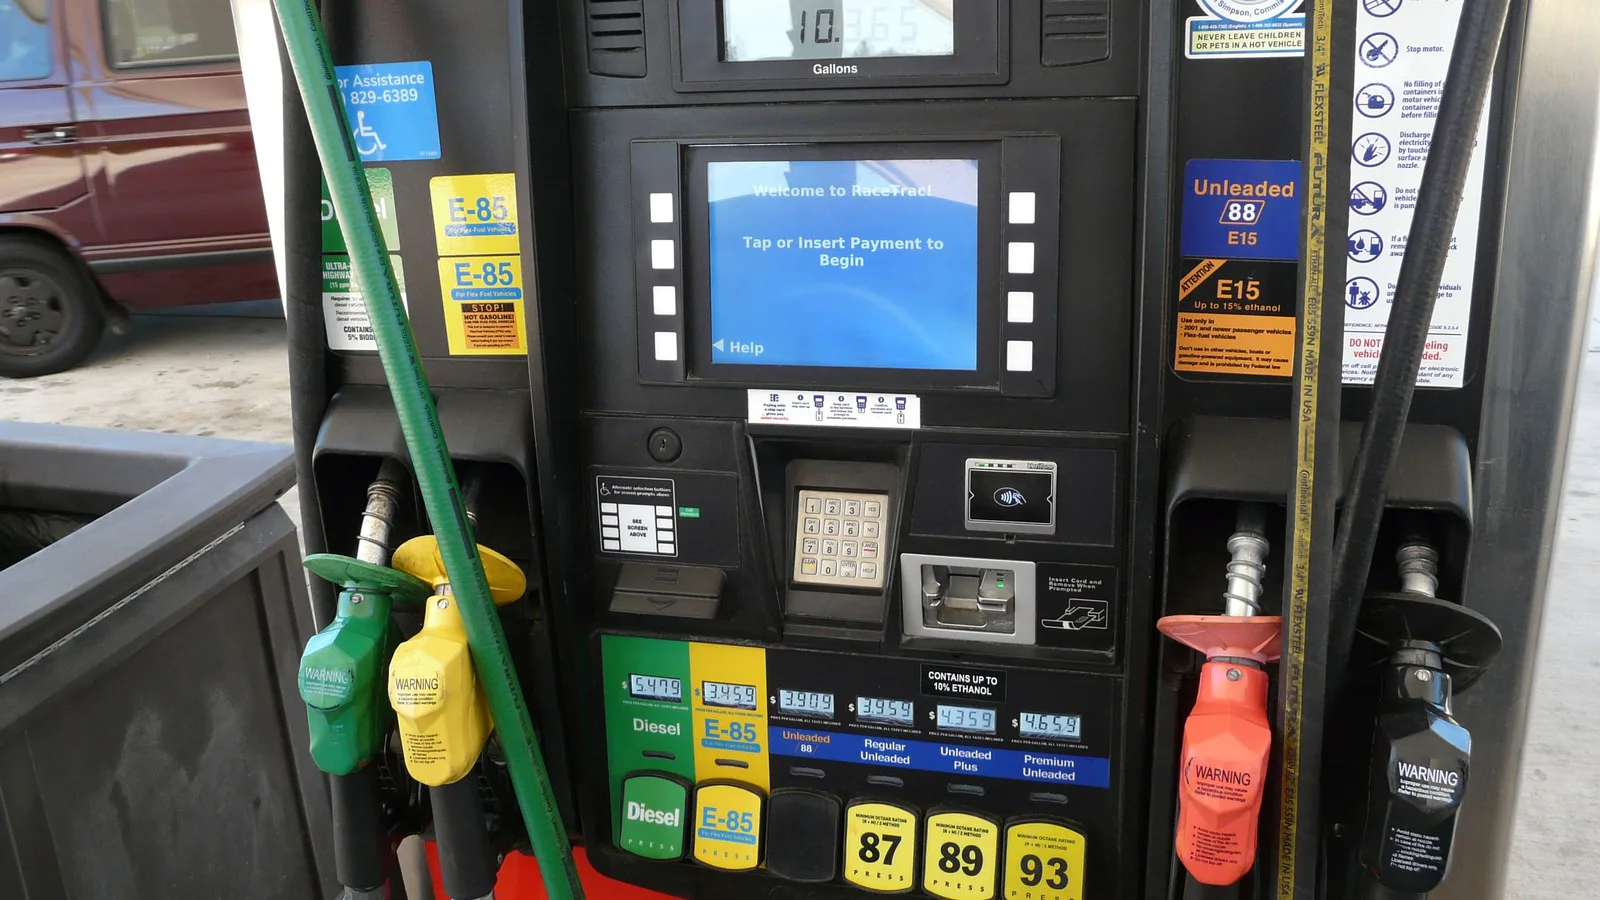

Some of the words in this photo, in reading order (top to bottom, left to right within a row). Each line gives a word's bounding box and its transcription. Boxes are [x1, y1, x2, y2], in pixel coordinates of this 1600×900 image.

[1406, 45, 1421, 53] Stop
[813, 63, 858, 74] Gallons
[353, 73, 425, 87] Assistance
[1414, 80, 1433, 89] filling
[351, 89, 418, 104] 829-6389
[1399, 131, 1431, 140] Discharge
[753, 184, 824, 197] Welcome
[830, 185, 846, 197] to
[852, 184, 932, 197] RaceTrac!
[1194, 179, 1294, 197] Unleaded
[1311, 152, 1322, 239] FUTURA
[449, 197, 508, 222] E-85
[1228, 203, 1256, 222] 88
[743, 236, 772, 252] Tap
[777, 239, 793, 249] or
[798, 237, 845, 249] Insert
[850, 237, 922, 252] Payment
[927, 238, 944, 250] to
[1228, 231, 1257, 245] E15
[819, 254, 864, 269] Begin
[323, 271, 351, 279] HIGHWA
[455, 262, 514, 286] E-85
[1181, 260, 1215, 292] ATTENTION
[1216, 279, 1260, 300] E15
[472, 304, 504, 312] STOP!
[1194, 302, 1207, 310] Up
[1245, 304, 1281, 312] ethanol
[1307, 297, 1316, 315] E85
[730, 342, 764, 356] Help
[1349, 338, 1361, 347] DO
[1363, 339, 1381, 347] NOT
[1353, 350, 1381, 358] vehicl
[1304, 349, 1314, 381] MADE
[1304, 384, 1313, 397] IN
[1303, 400, 1313, 422] USA
[1300, 470, 1310, 516] Continental
[305, 667, 349, 684] WARNING
[928, 671, 971, 684] CONTAINS
[972, 675, 984, 684] UP
[986, 676, 997, 685] TO
[396, 678, 438, 690] WARNING
[621, 681, 627, 689] $
[635, 677, 680, 695] 5.479
[933, 682, 950, 692] 10%
[952, 683, 992, 696] ETHANOL
[695, 688, 700, 697] $
[709, 684, 754, 703] 3.459
[770, 695, 776, 704] $
[785, 690, 832, 710] 3.909
[848, 703, 855, 712] $
[863, 699, 911, 717] 3.959
[928, 711, 935, 720] $
[941, 709, 992, 728] 4.359
[1011, 718, 1018, 728] $
[1025, 714, 1076, 733] 4.659
[633, 718, 680, 735] Diesel
[704, 718, 757, 743] E-85
[782, 730, 830, 744] Unleaded
[800, 744, 812, 753] 88
[864, 738, 906, 752] Regular
[860, 751, 910, 765] Unleaded
[940, 746, 992, 760] Unleaded
[954, 761, 978, 772] Plus
[1024, 754, 1075, 768] Premium
[1023, 767, 1075, 781] Unleaded
[1195, 765, 1251, 786] WARNING
[1398, 761, 1458, 786] WARNING
[627, 801, 680, 827] Diesel
[702, 806, 753, 833] E-85
[628, 838, 674, 851] PRESS
[858, 832, 902, 866] 87
[1282, 831, 1293, 861] MADE
[703, 848, 750, 861] PRESS
[938, 842, 983, 876] 89
[854, 869, 904, 882] PRESS
[1020, 854, 1069, 890] 93
[1282, 862, 1291, 874] IN
[934, 880, 984, 892] PRESS
[1281, 875, 1290, 896] USA
